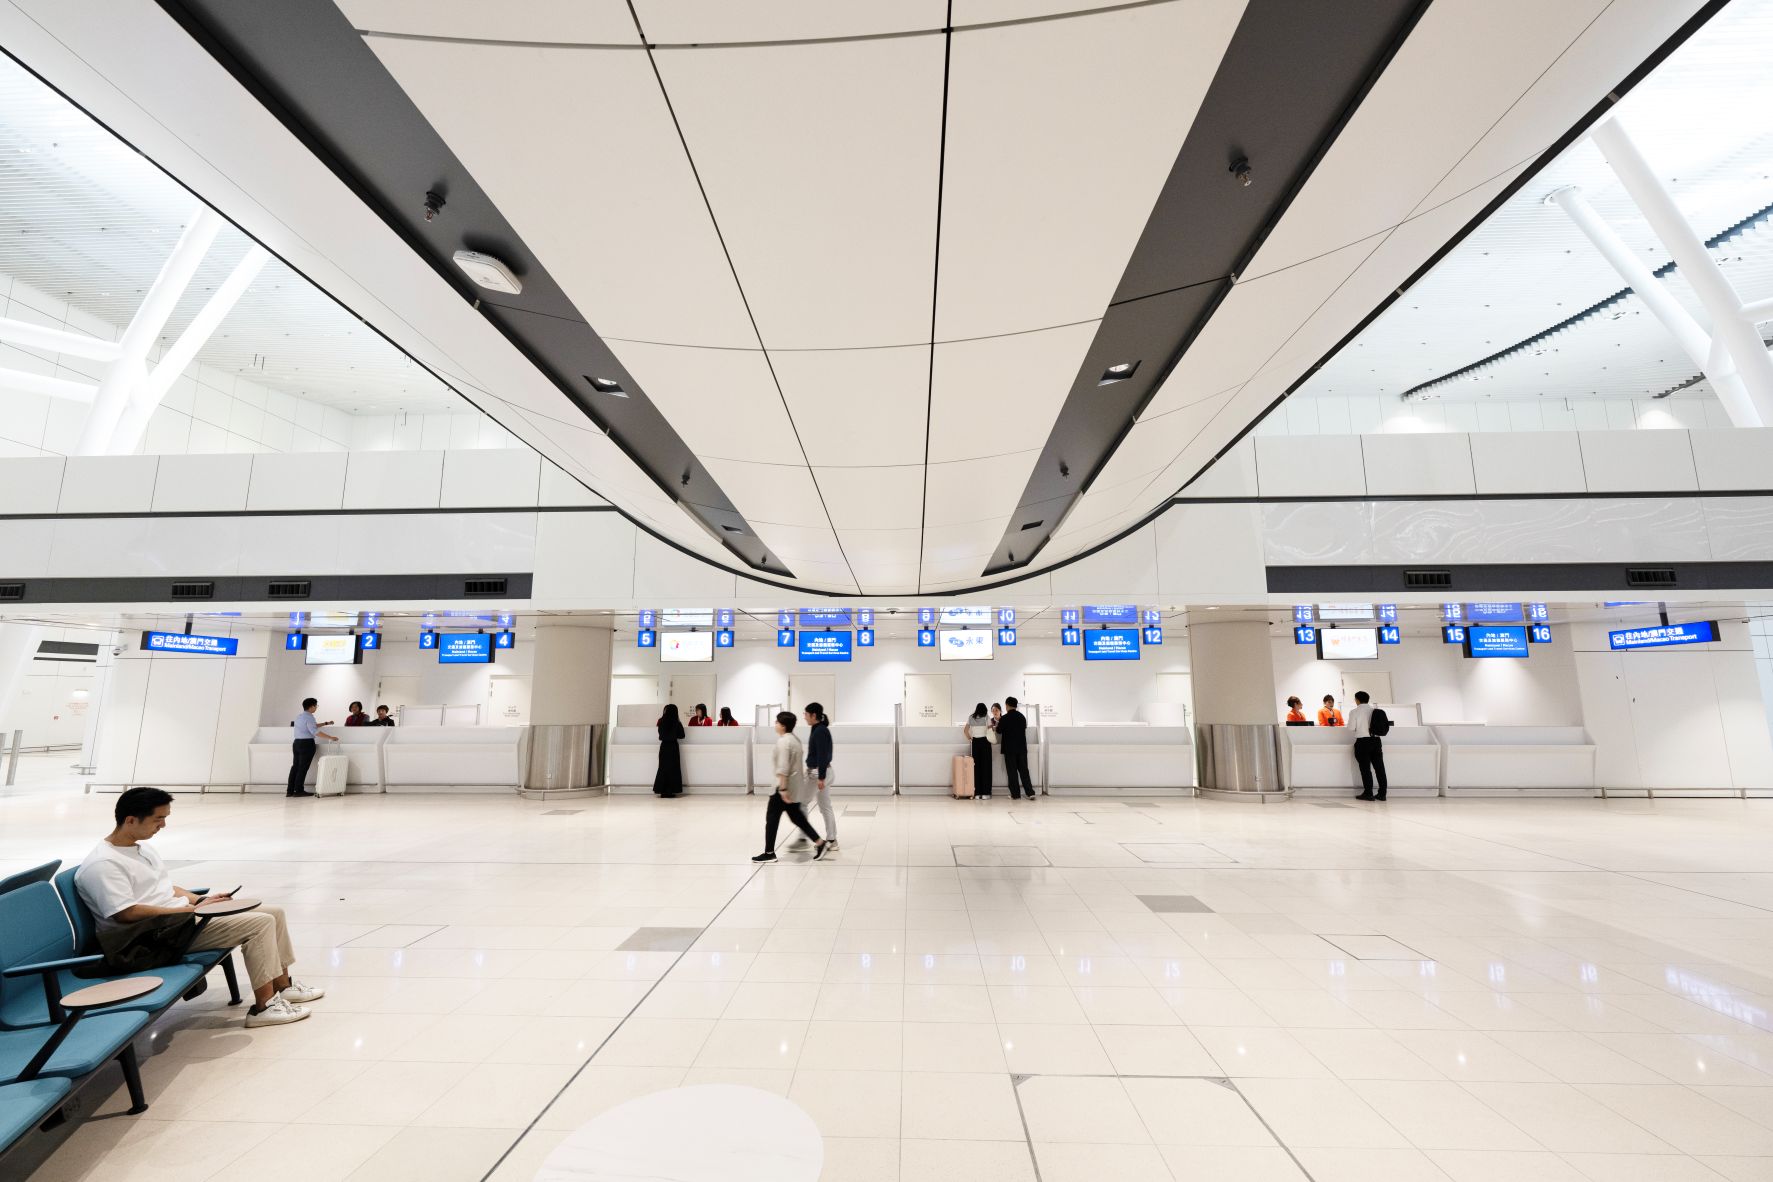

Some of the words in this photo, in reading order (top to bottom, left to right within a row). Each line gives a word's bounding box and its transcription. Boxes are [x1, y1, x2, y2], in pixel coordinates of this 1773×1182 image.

[642, 633, 650, 644] 5
[720, 633, 729, 644] 6
[782, 633, 790, 644] 7
[862, 632, 870, 644] 8
[922, 632, 930, 644] 9
[1000, 631, 1014, 643] 10
[1065, 631, 1077, 642] 11
[1145, 631, 1160, 642] 12
[1298, 630, 1314, 641] 13
[1382, 629, 1398, 641] 14
[1448, 629, 1464, 640] 15
[1533, 628, 1550, 640] 16
[292, 636, 297, 647] 1
[365, 636, 373, 646] 2
[424, 635, 432, 646] 3
[499, 635, 508, 646] 4
